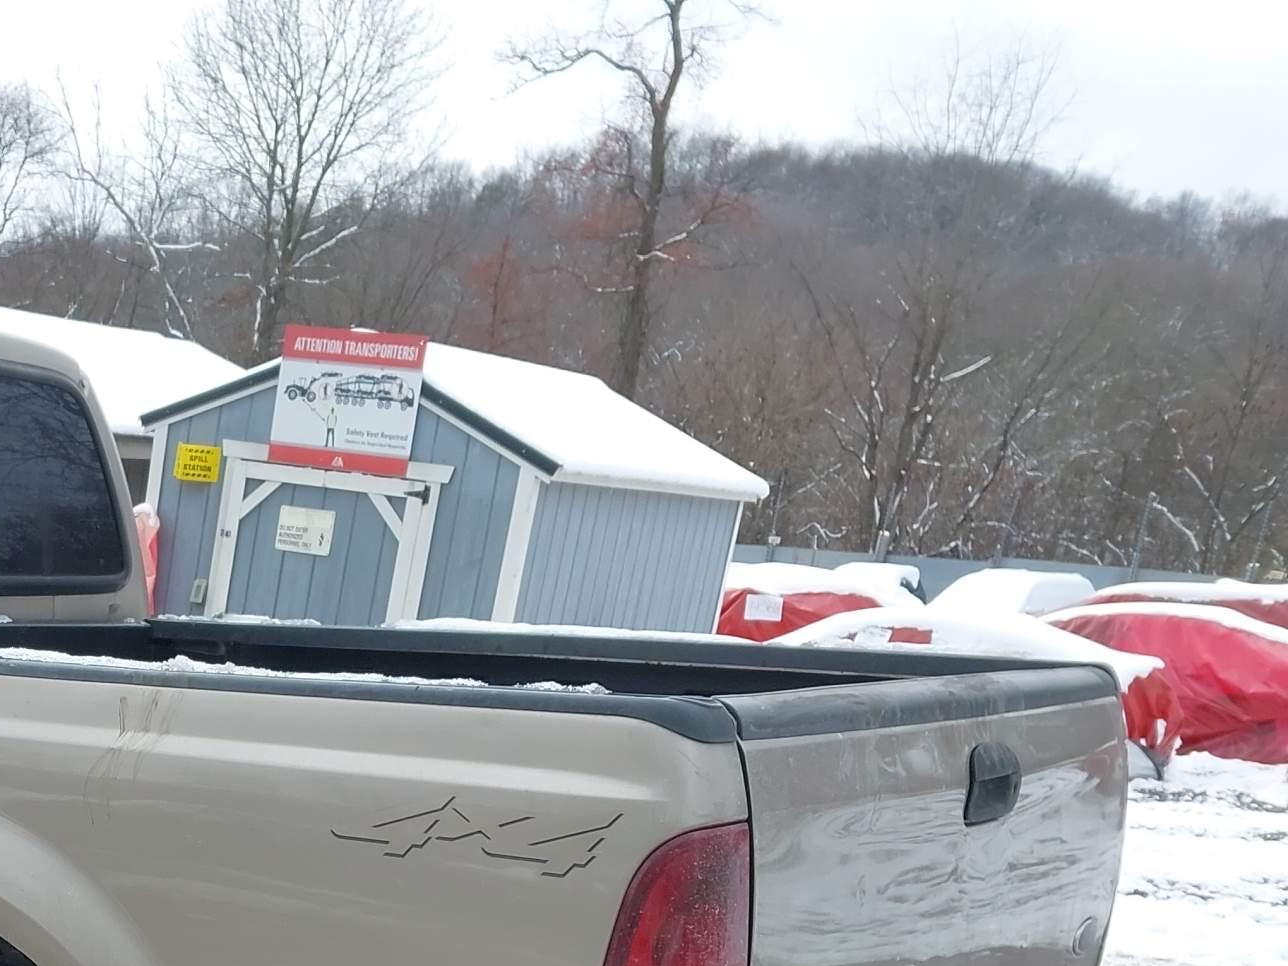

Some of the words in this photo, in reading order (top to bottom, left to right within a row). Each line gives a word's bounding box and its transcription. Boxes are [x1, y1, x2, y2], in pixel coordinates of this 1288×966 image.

[294, 337, 343, 354] ATTENTION
[345, 341, 419, 361] TRANSPORTERS!
[346, 427, 365, 438] Safety
[367, 430, 380, 439] Vest
[381, 431, 409, 442] Required
[190, 455, 209, 464] SPILL
[183, 463, 213, 473] STATION
